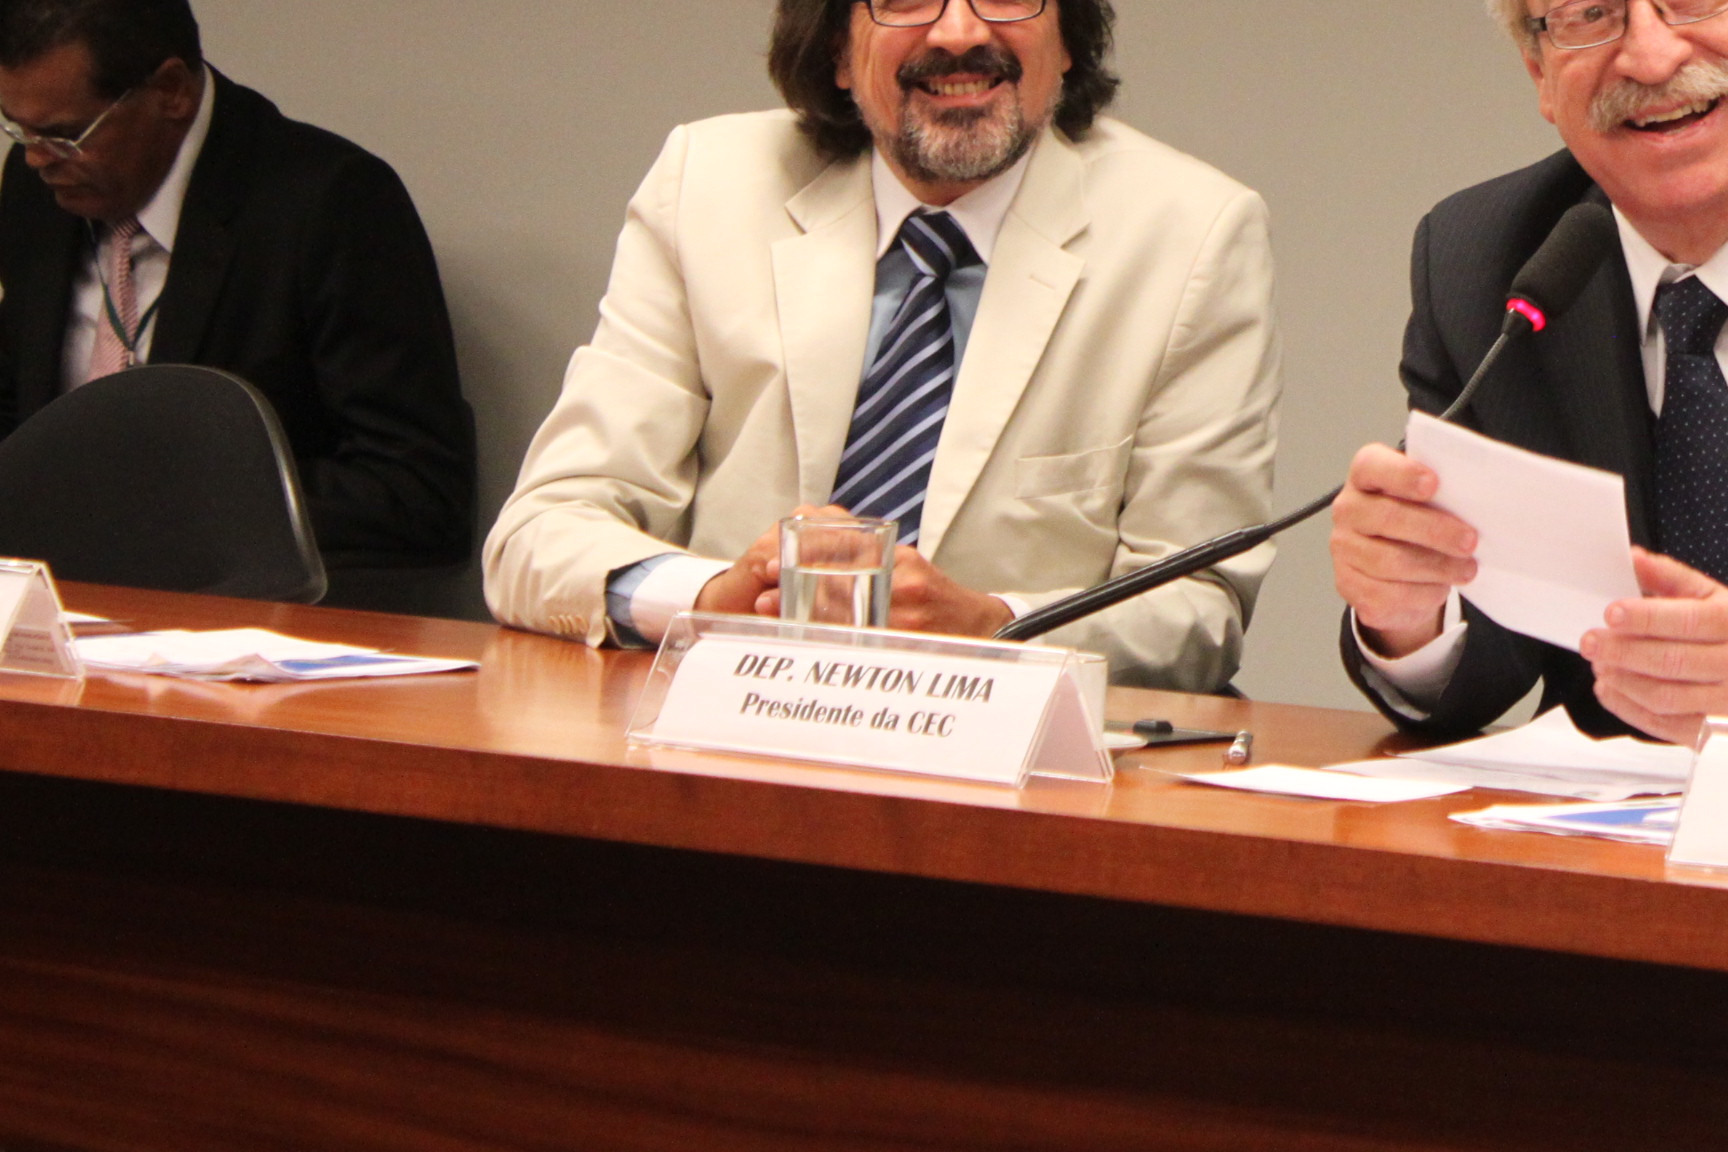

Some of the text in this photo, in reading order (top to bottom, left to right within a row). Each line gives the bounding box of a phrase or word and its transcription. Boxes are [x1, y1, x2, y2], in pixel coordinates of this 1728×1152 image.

[733, 653, 996, 703] DEP. NEWTON LIMA
[739, 692, 956, 738] Presidente da CEC
